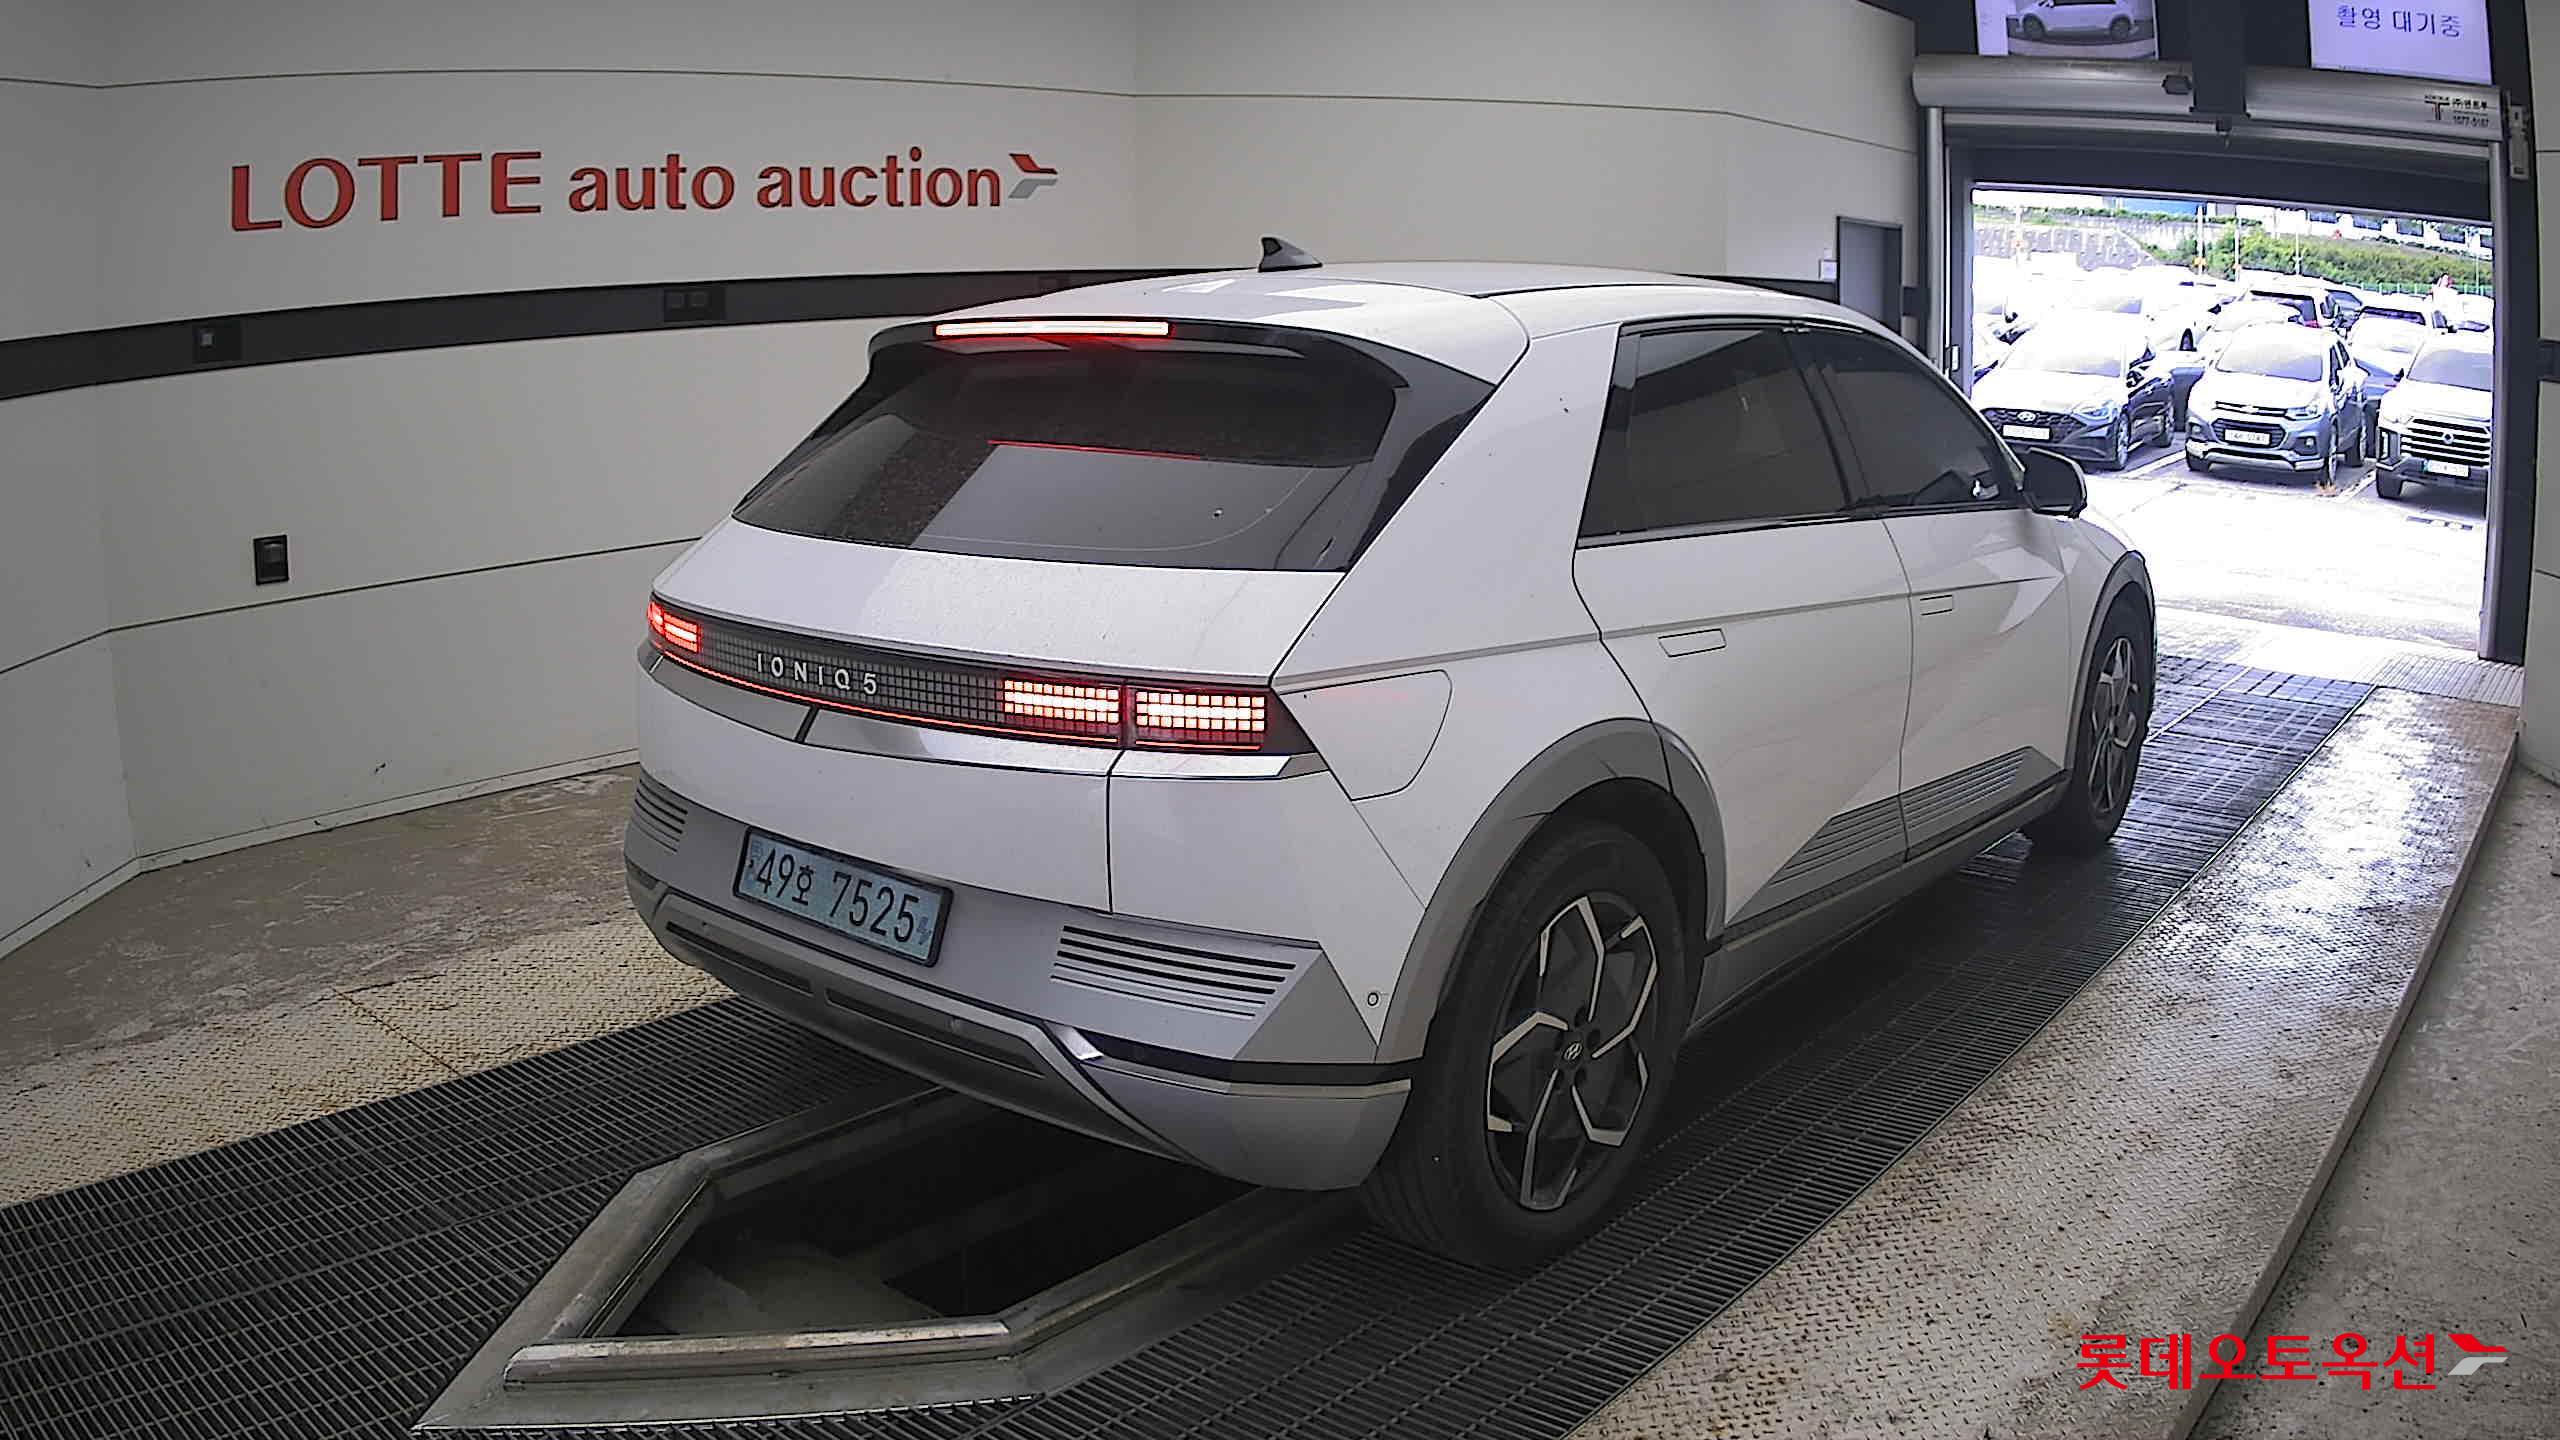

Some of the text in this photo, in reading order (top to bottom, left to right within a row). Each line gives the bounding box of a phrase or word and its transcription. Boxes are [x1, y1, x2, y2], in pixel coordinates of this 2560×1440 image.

[2337, 4, 2462, 39] 촬영 대기중
[231, 146, 1001, 232] LOTTE auto auction
[757, 652, 878, 695] IONIQ 5
[757, 847, 814, 906] 49호
[829, 870, 920, 943] 7525
